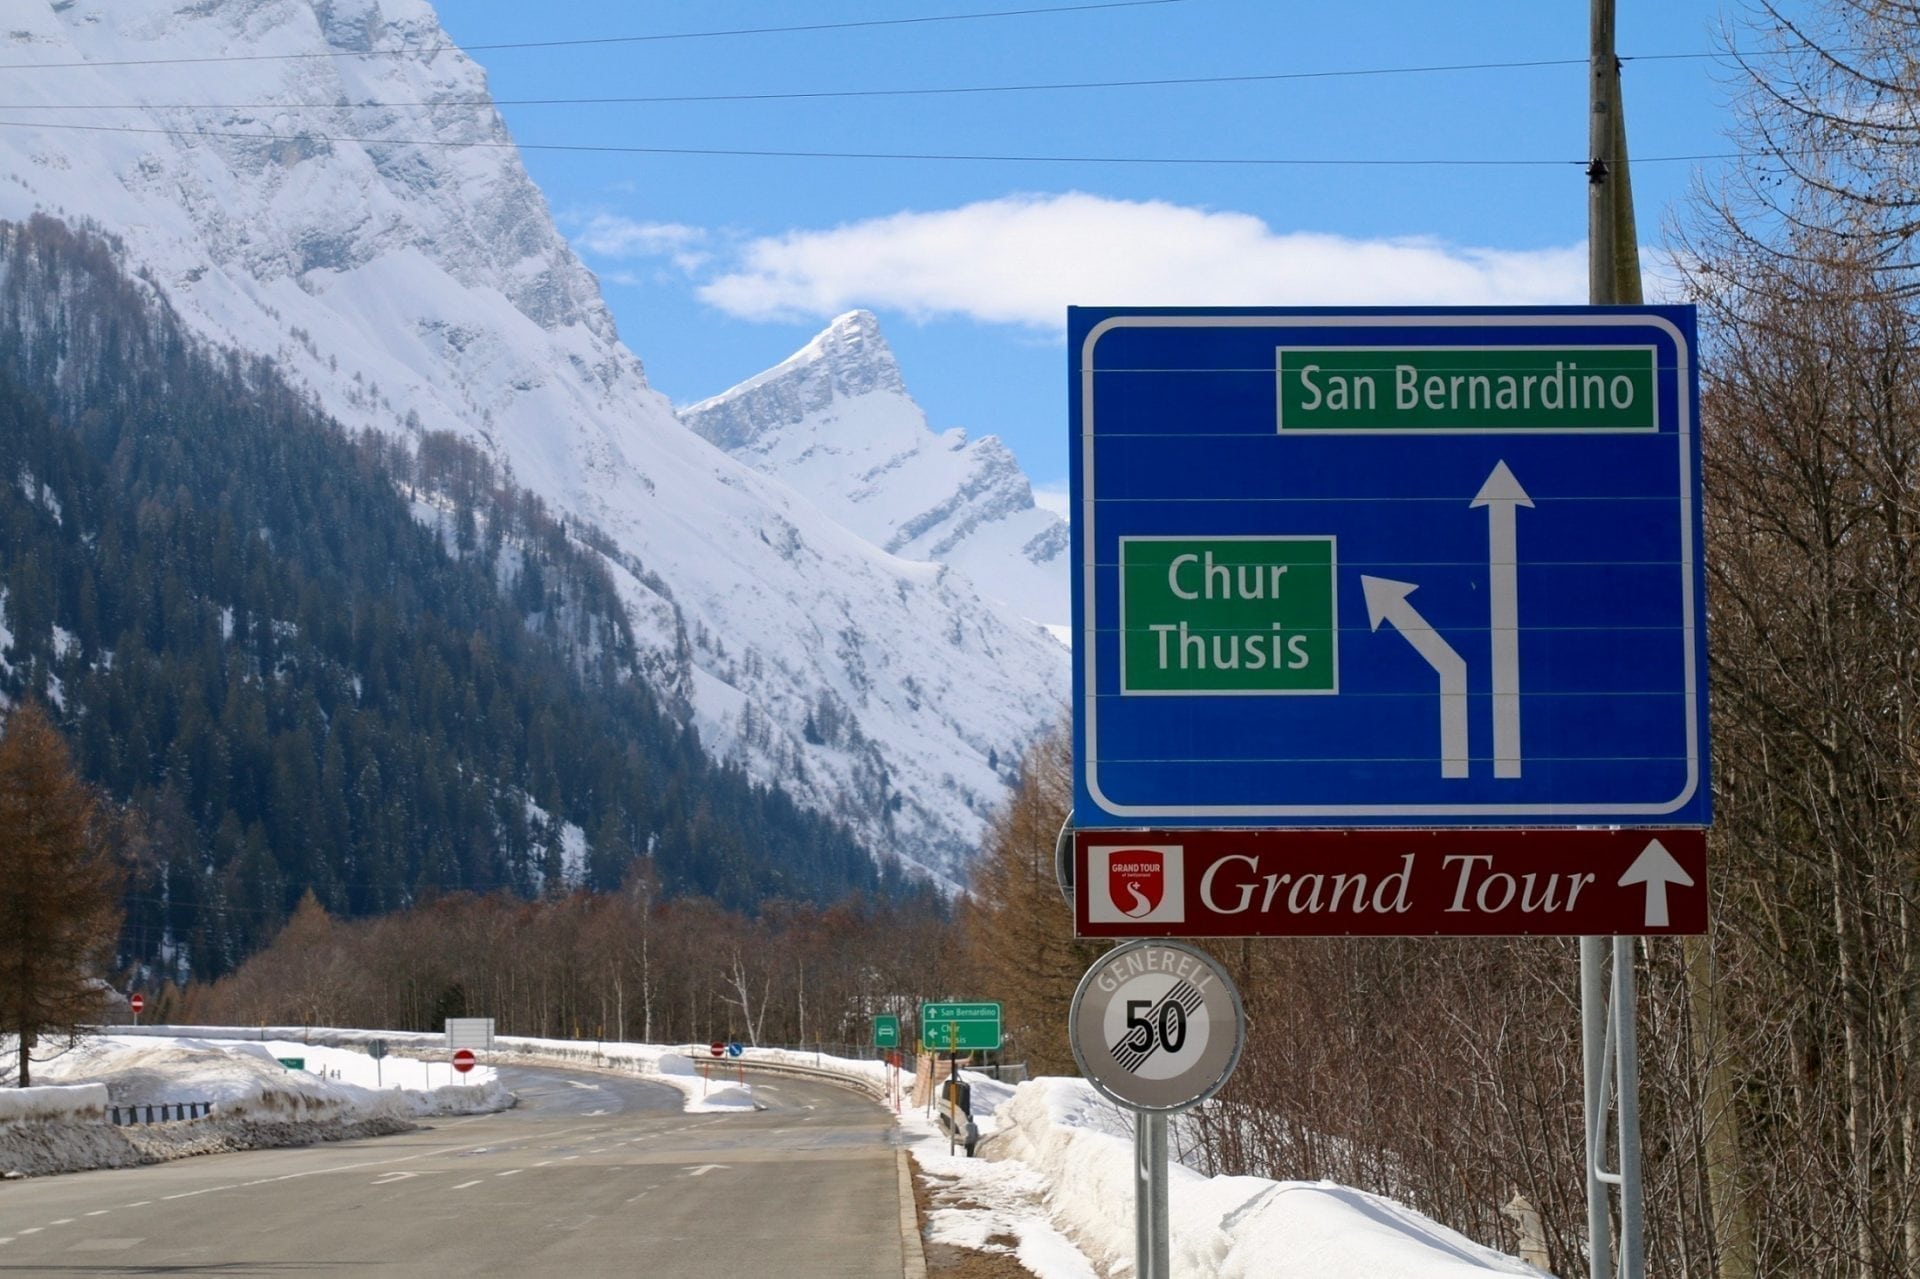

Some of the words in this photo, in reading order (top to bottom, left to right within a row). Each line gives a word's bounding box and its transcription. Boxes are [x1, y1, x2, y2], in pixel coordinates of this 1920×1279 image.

[1301, 365, 1376, 410] San
[1396, 361, 1635, 410] Bernardino
[1168, 551, 1288, 600] Chur
[1149, 621, 1309, 670] Thusis
[1112, 864, 1139, 872] GRAND
[1140, 864, 1160, 872] TOUR
[1200, 853, 1415, 914] Grand
[1442, 854, 1596, 913] Tour
[1097, 950, 1214, 994] GENERELL
[941, 1008, 954, 1016] San
[956, 1008, 996, 1016] Bernardino
[941, 1024, 960, 1032] Chr
[1126, 1000, 1187, 1053] 50
[942, 1035, 966, 1043] Thsis
